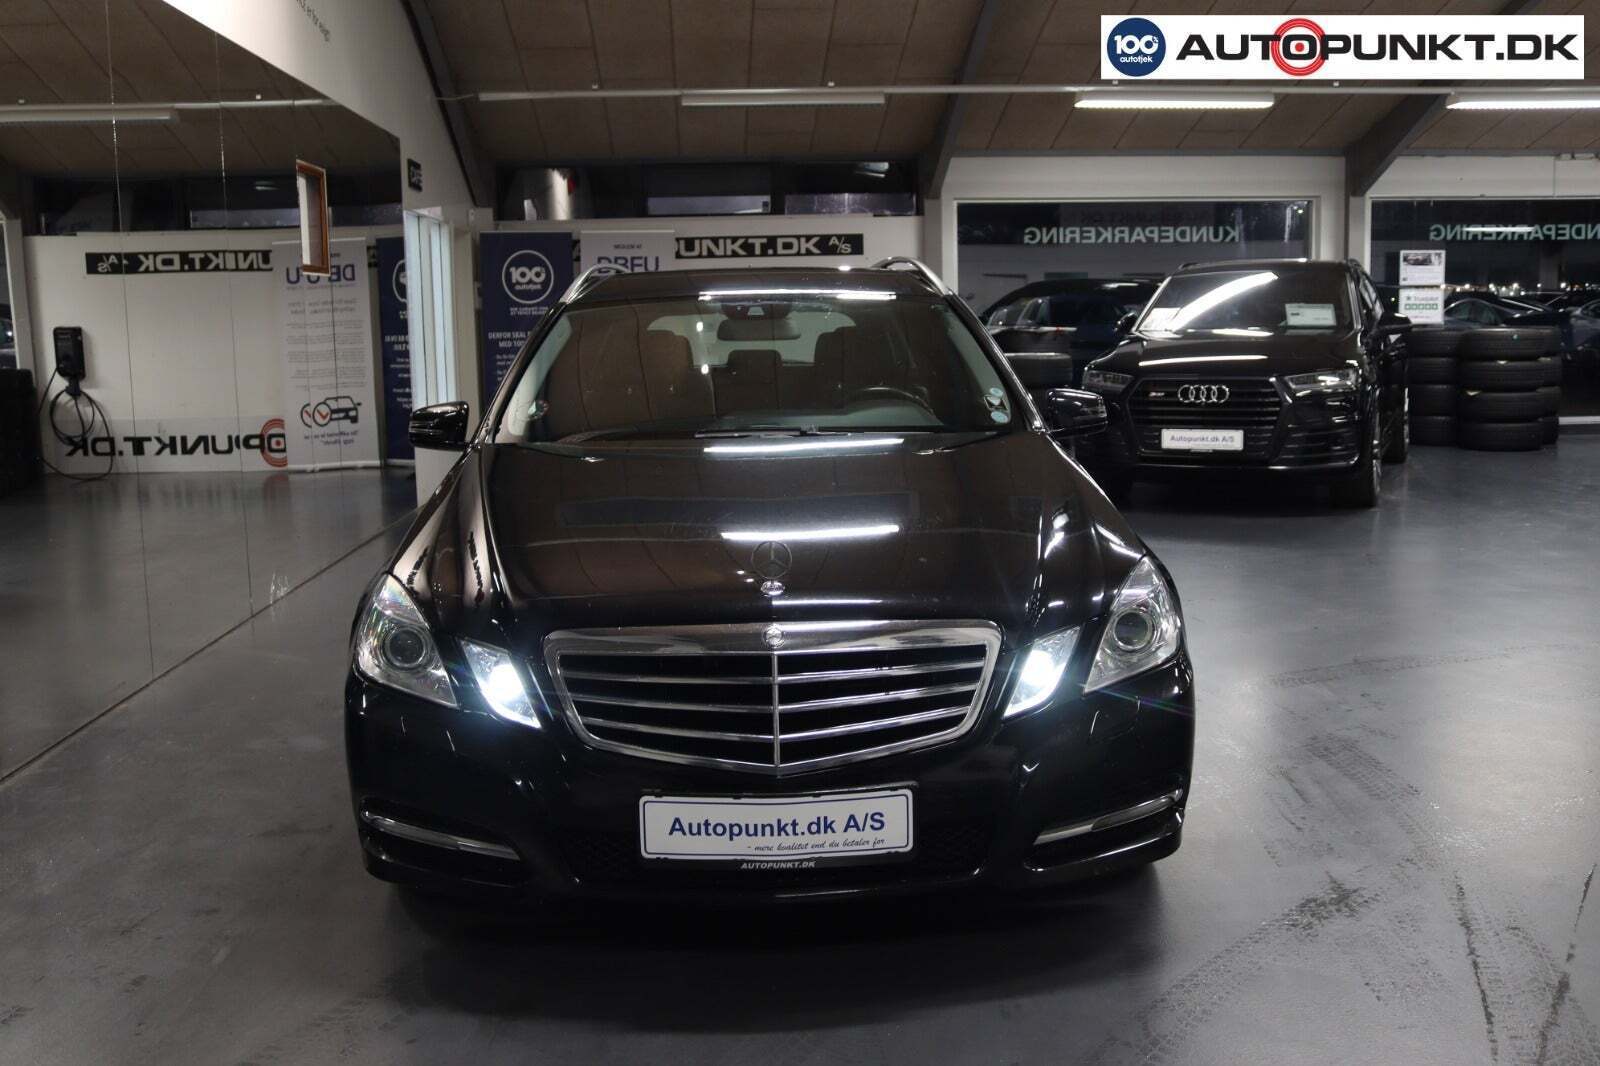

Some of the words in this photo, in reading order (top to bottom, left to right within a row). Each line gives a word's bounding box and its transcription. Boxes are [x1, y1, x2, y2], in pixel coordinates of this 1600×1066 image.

[675, 236, 822, 257] UNKT.DK
[828, 235, 852, 255] A/S
[1170, 435, 1220, 444] Autopunkt.dk
[668, 815, 837, 842] Autopunkt.dk
[843, 811, 886, 833] A/S
[776, 839, 809, 851] kvalitet
[811, 838, 827, 849] end
[829, 839, 841, 848] du
[843, 837, 870, 848] betaler
[872, 837, 886, 849] for
[740, 860, 817, 870] AUTOPUNKT.DK
